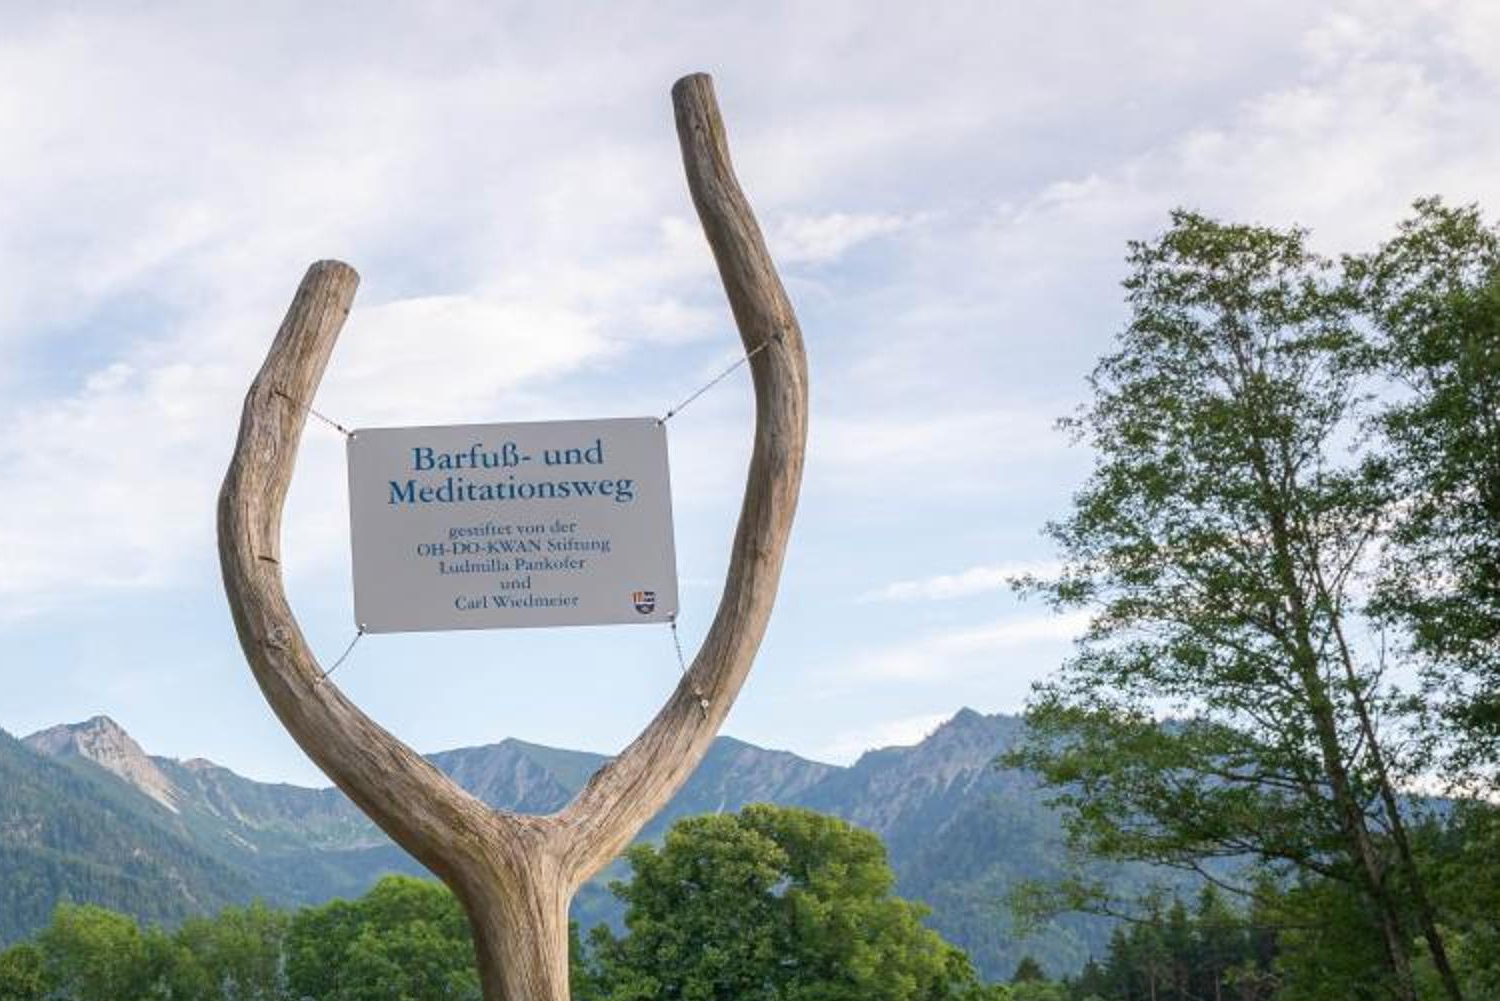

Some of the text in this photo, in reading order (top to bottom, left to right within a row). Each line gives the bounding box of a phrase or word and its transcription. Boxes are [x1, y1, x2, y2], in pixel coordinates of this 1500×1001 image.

[412, 438, 604, 471] Barfuß- und
[388, 475, 634, 505] Meditationsweg
[449, 519, 577, 540] gestiftet von der
[417, 538, 611, 557] OH-DO-KWAN Stiftung
[438, 557, 586, 575] Ludmilla Pankofer
[500, 576, 531, 590] und
[455, 593, 579, 611] Carl Wiedmeier
